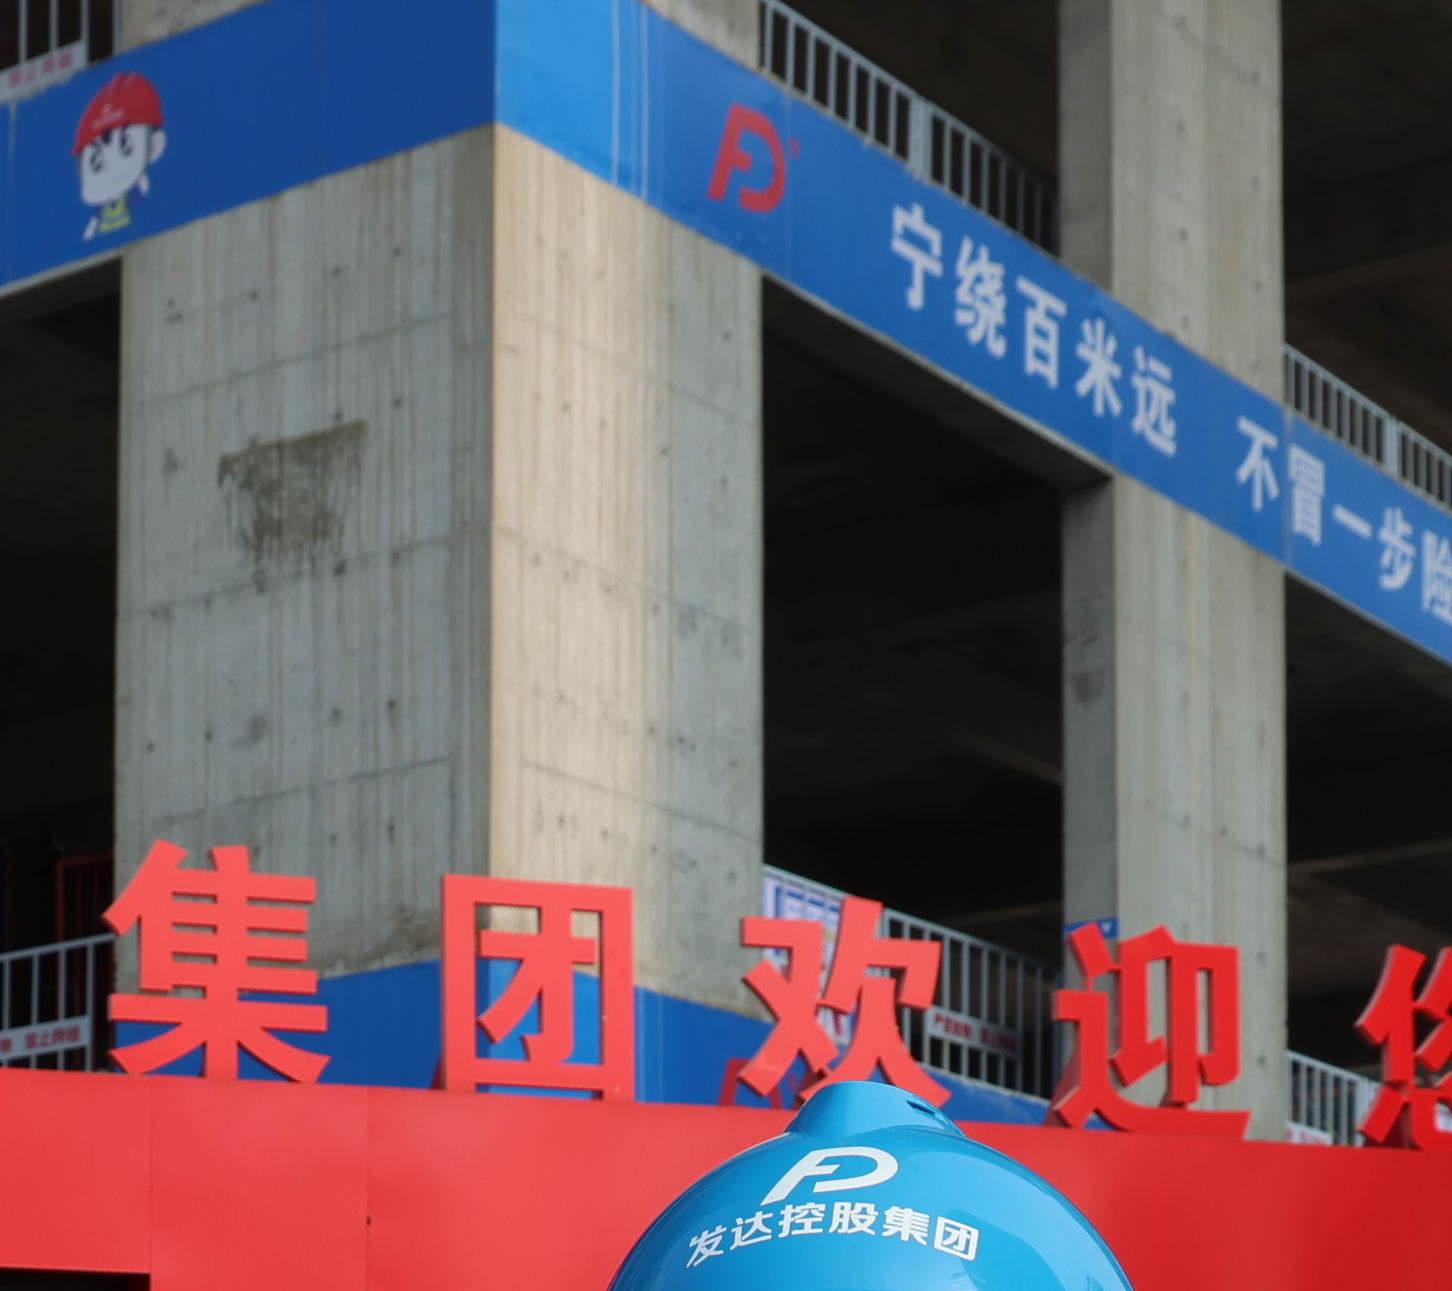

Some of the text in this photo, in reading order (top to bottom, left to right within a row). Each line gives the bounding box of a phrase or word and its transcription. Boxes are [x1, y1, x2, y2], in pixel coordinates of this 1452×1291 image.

[891, 203, 1177, 457] 宁绕百米远
[686, 1201, 980, 1269] 发达控股集团
